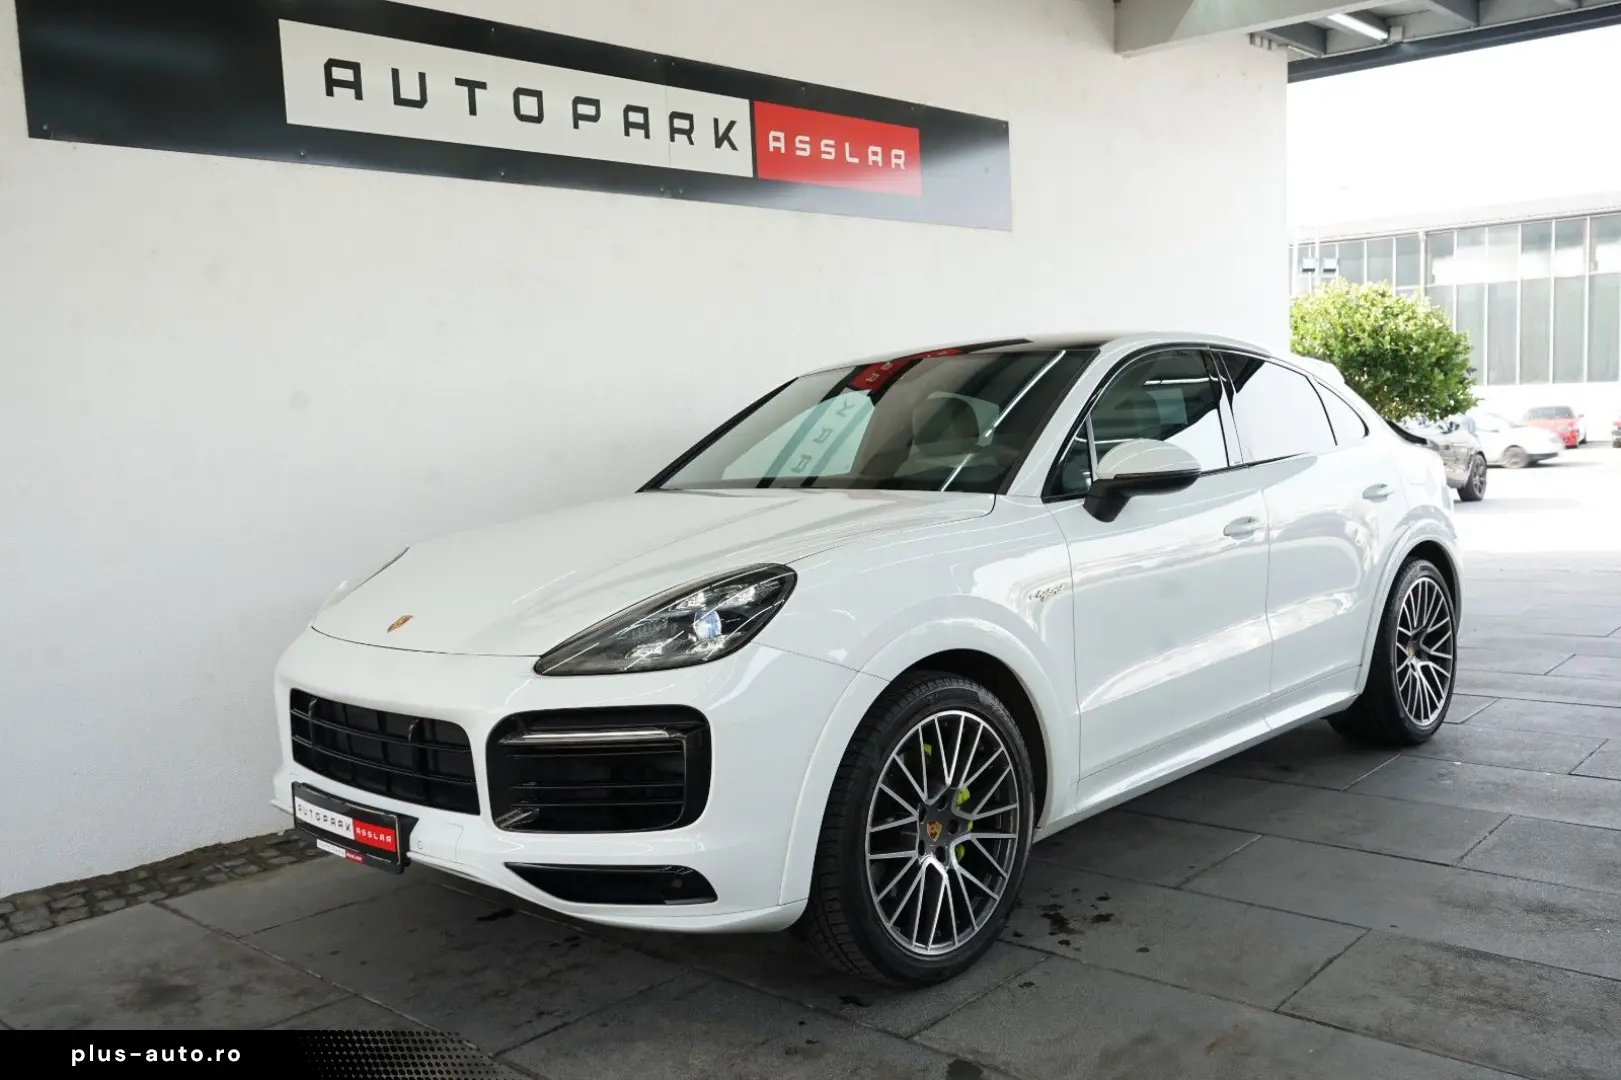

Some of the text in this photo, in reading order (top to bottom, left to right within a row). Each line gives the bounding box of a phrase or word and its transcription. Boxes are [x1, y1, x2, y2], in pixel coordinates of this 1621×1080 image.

[323, 57, 906, 170] AUTOPARK ASSLAR
[297, 803, 392, 843] AUTOPARK ASSLAR
